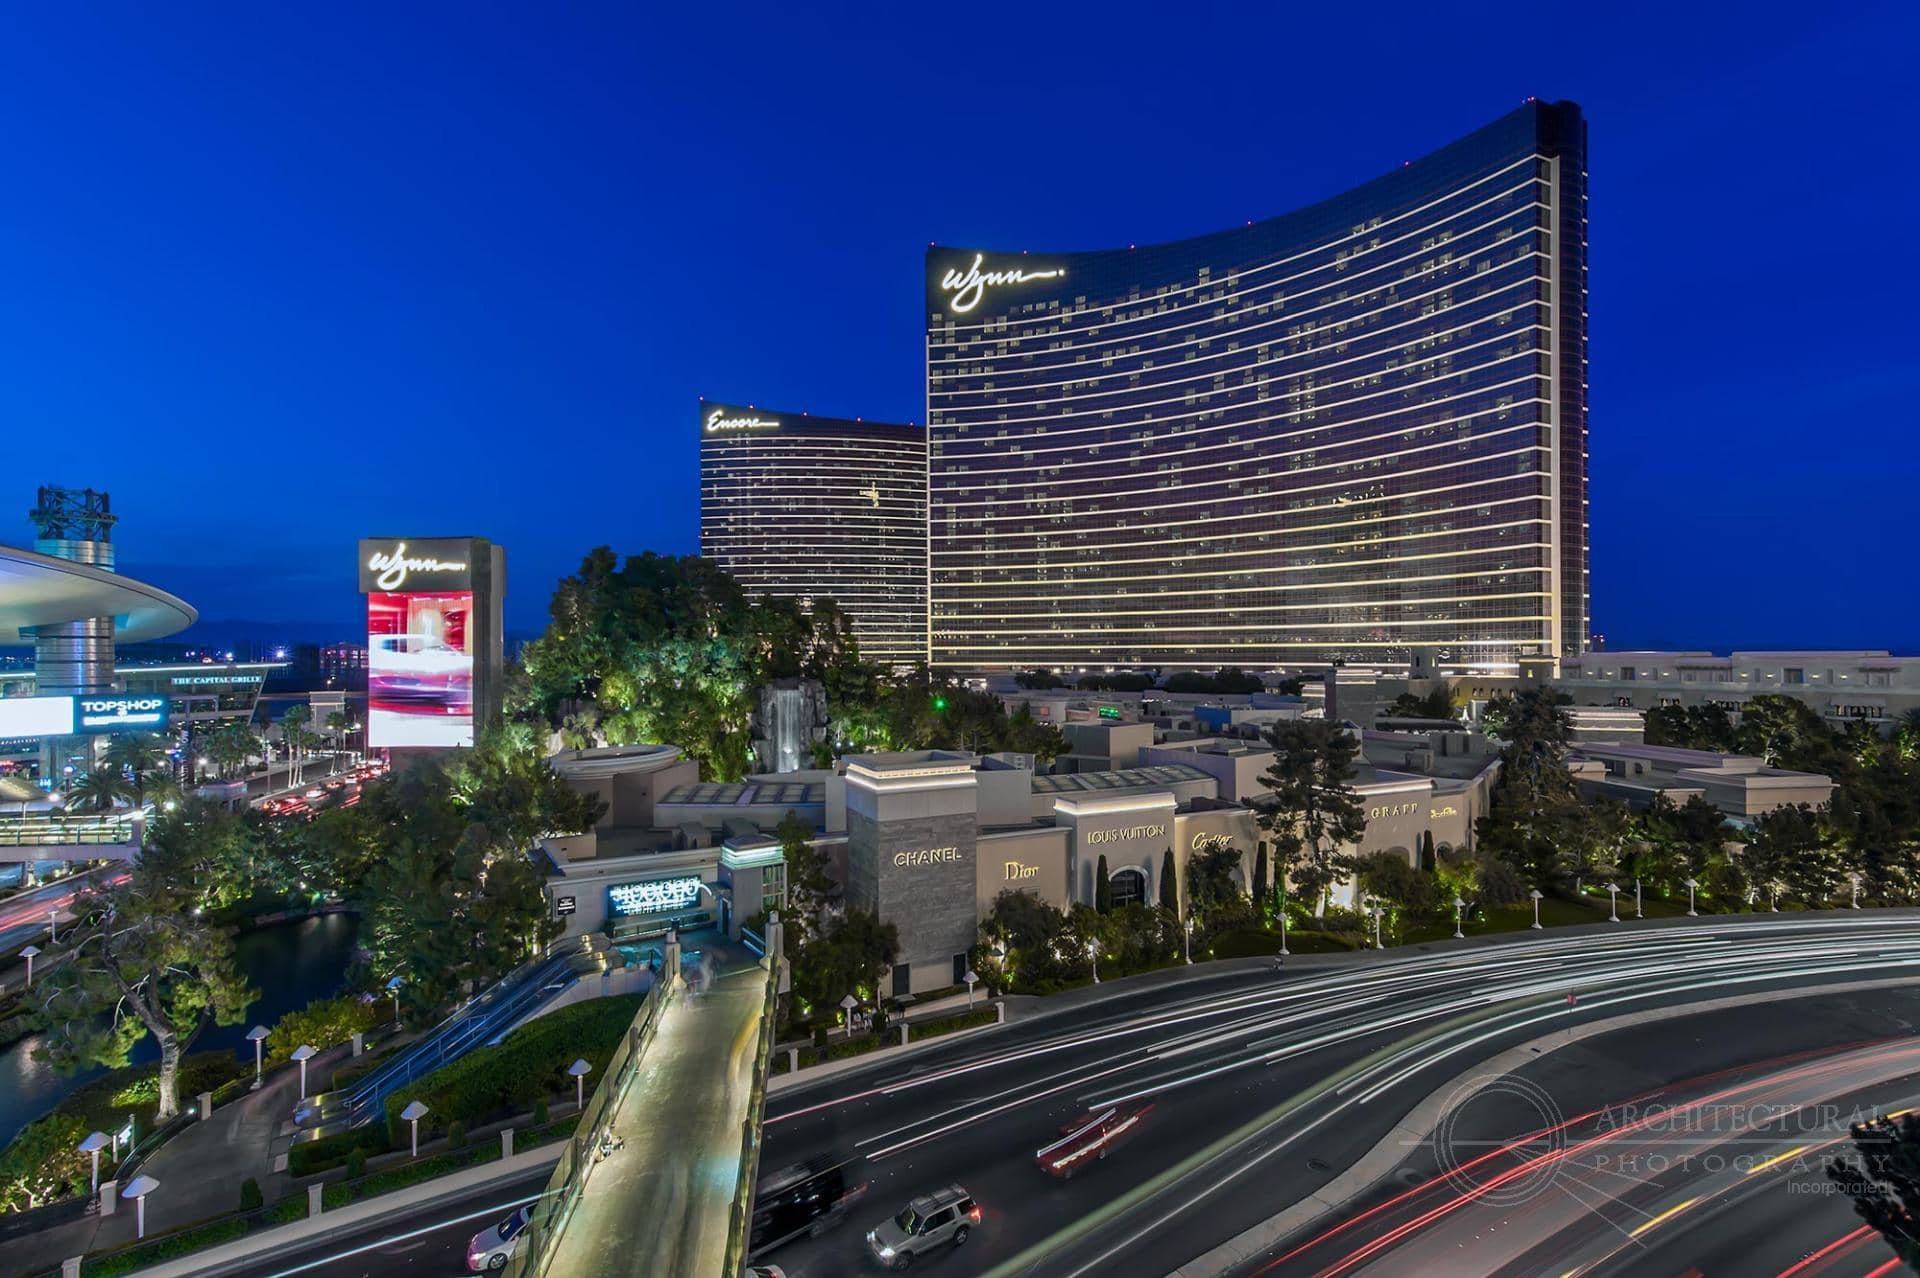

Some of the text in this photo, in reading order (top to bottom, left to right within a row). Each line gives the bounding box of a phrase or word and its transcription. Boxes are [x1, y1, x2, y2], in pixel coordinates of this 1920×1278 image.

[707, 409, 780, 431] Encore
[173, 675, 262, 686] THE CAPITAL GRILLE
[82, 700, 162, 712] TOPSHOP
[1087, 824, 1166, 845] LOUIS VUITTON
[894, 847, 963, 867] CHANEL
[1005, 861, 1040, 880] Dior
